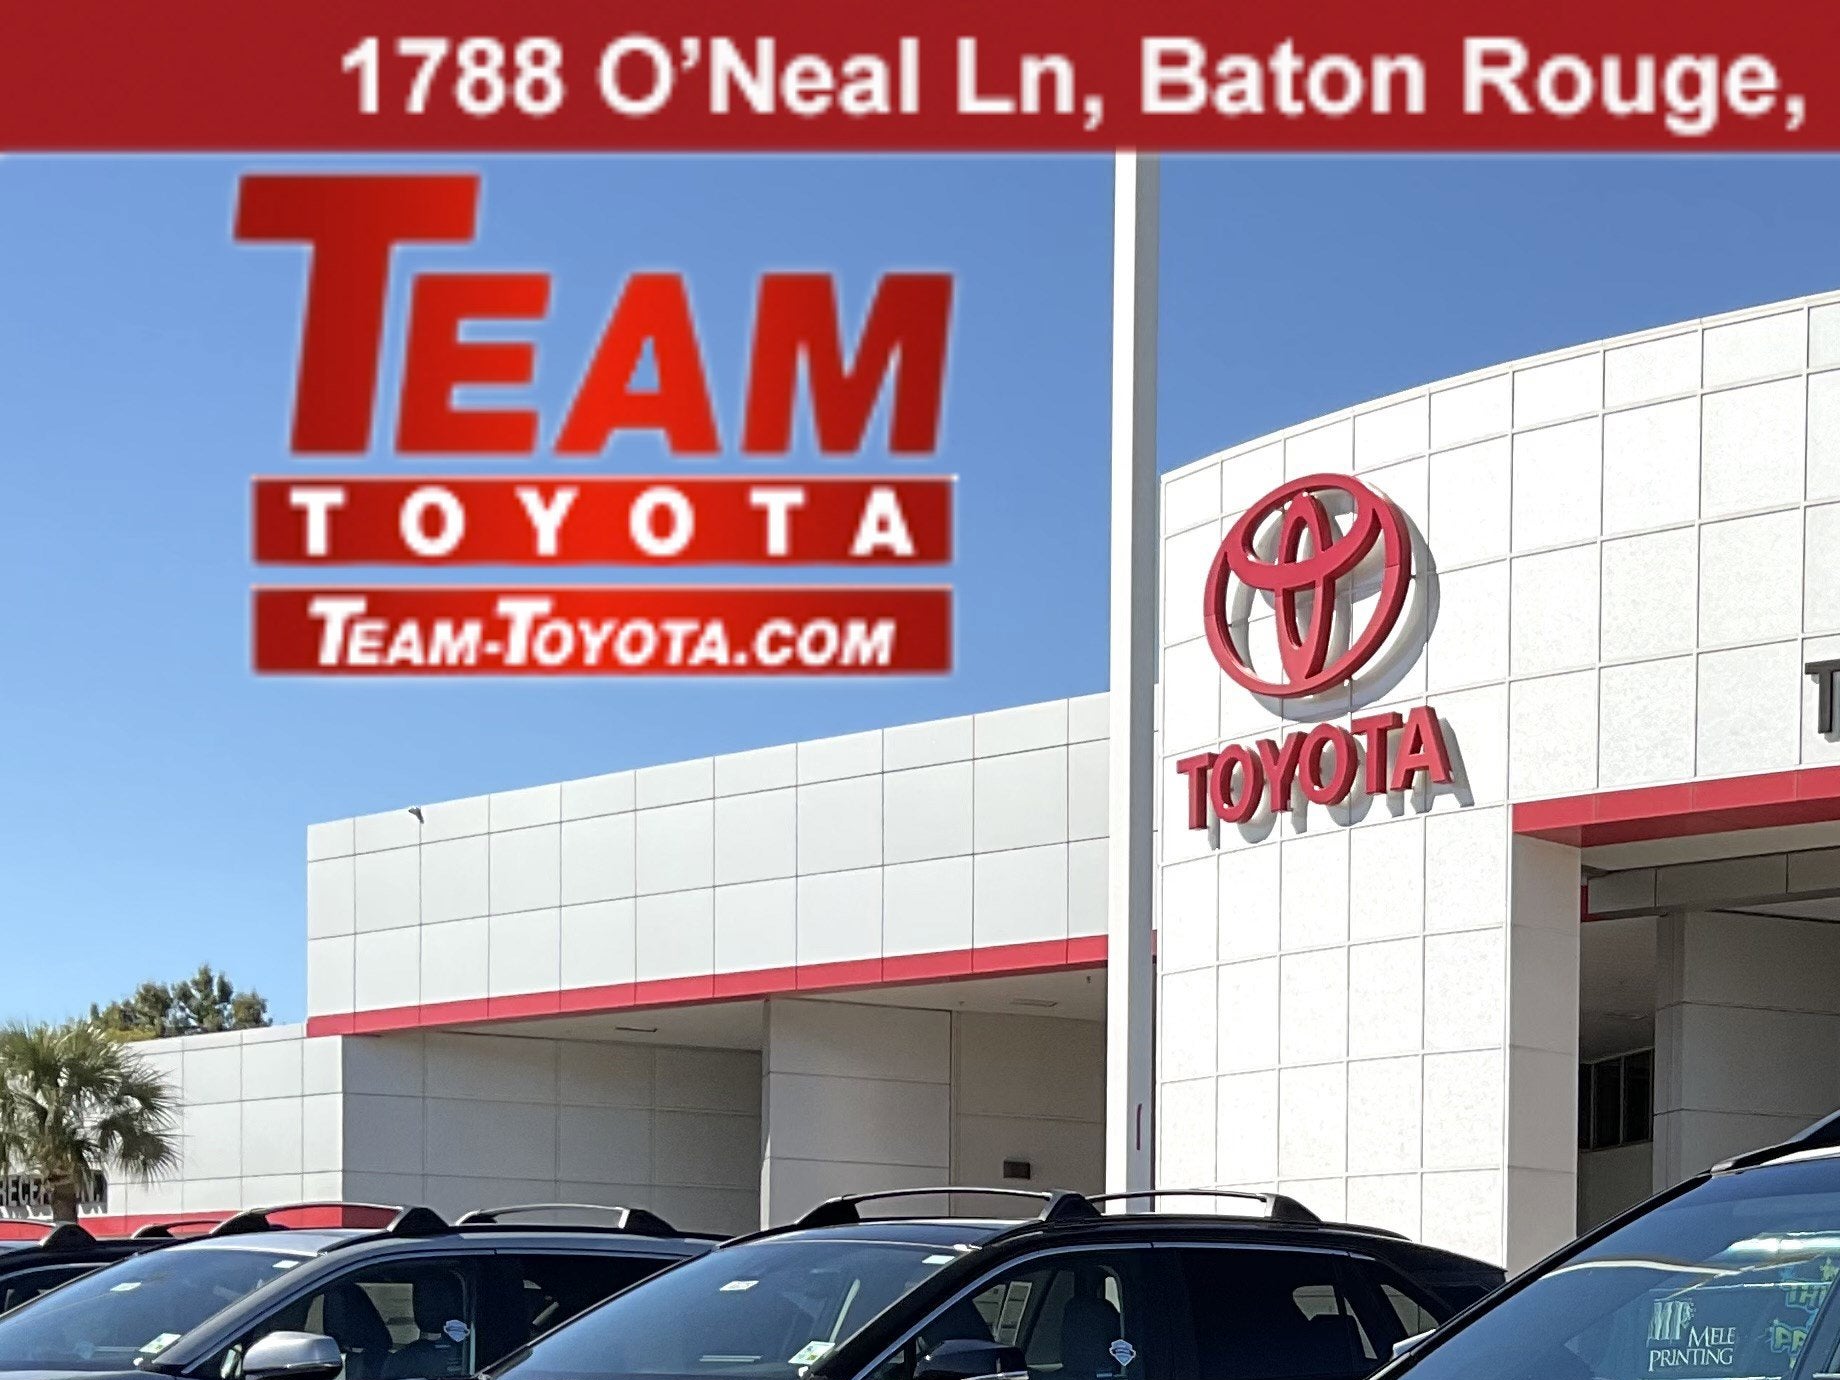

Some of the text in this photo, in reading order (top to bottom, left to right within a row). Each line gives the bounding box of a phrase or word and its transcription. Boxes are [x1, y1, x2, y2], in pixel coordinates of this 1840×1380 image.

[1176, 705, 1455, 830] TOYOTA
[1688, 1325, 1737, 1348] MELE
[1648, 1347, 1735, 1372] PRINTING
